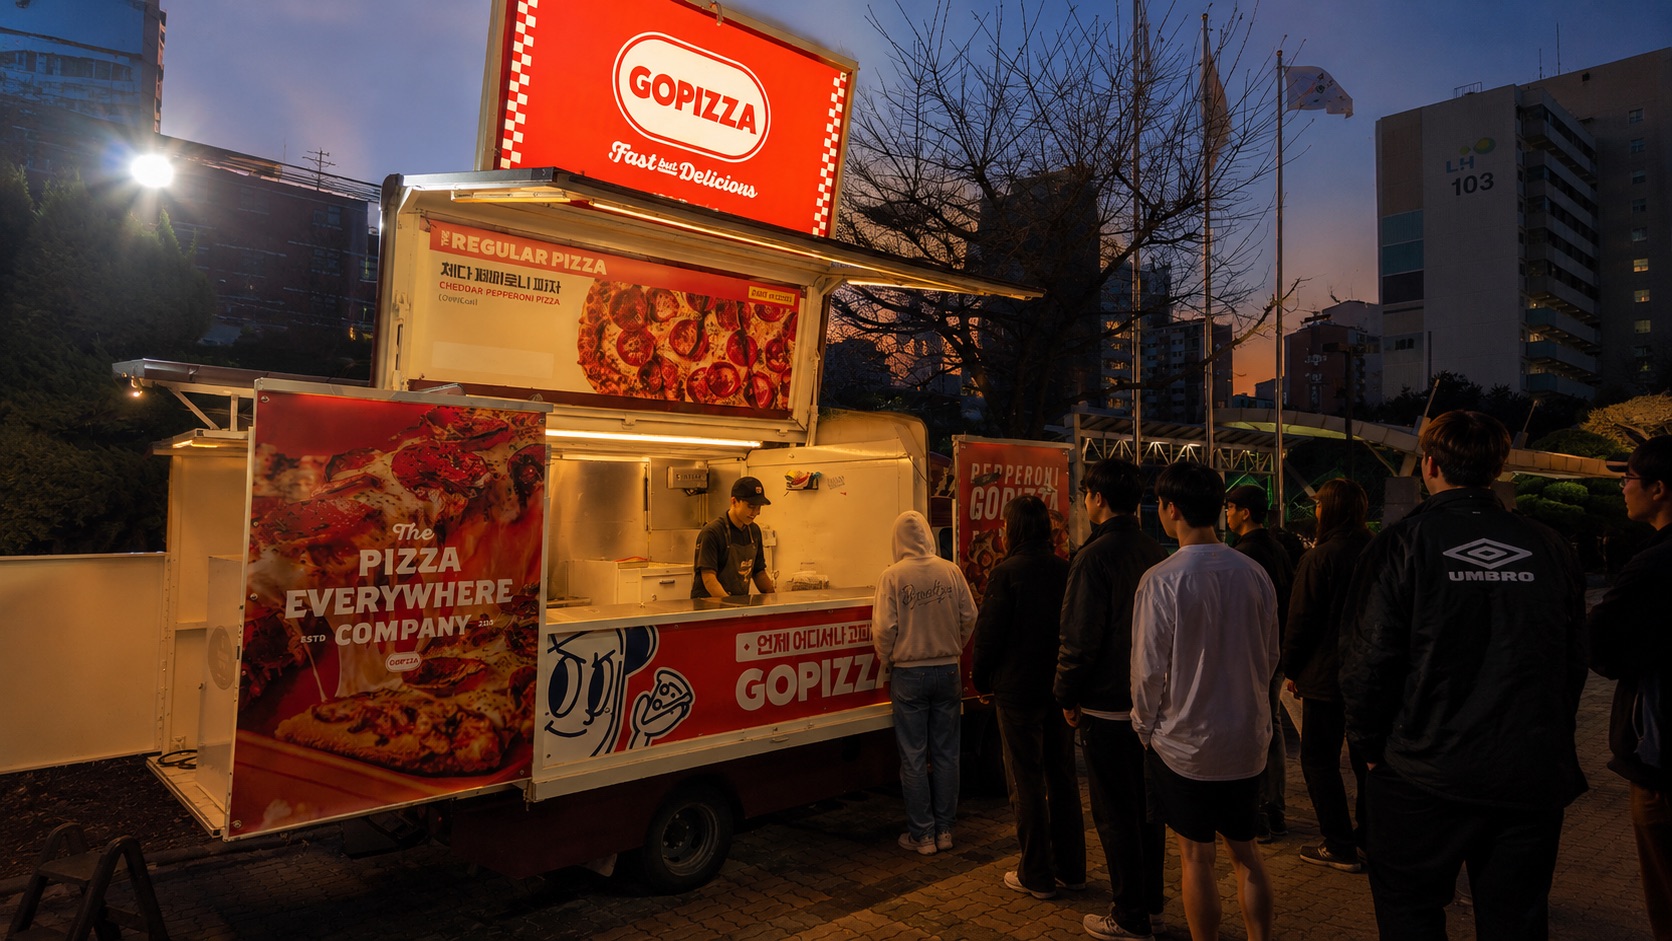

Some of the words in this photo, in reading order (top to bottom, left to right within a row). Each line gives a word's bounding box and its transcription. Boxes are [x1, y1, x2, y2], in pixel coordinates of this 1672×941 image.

[629, 65, 757, 135] GOPIZZA
[608, 140, 657, 171] Fast
[658, 157, 678, 174] but
[679, 161, 758, 198] Delicious
[1446, 156, 1474, 174] LH
[1451, 172, 1494, 196] 103
[452, 232, 548, 265] REGULAR
[552, 252, 607, 275] PIZZA
[439, 281, 483, 295] CHEDDAR
[486, 288, 534, 302] PEPPERONI
[536, 295, 561, 306] PIZZA
[970, 463, 1059, 487] PEPPERONI
[392, 522, 435, 541] The
[359, 547, 461, 577] PIZZA
[1449, 571, 1535, 582] UMBRO
[284, 578, 514, 619] EVERYWHERE
[300, 634, 326, 644] ESTD
[334, 614, 472, 646] COMPANY
[757, 632, 790, 655] 언제
[793, 626, 846, 650] 어디서나
[848, 624, 873, 644] 고피
